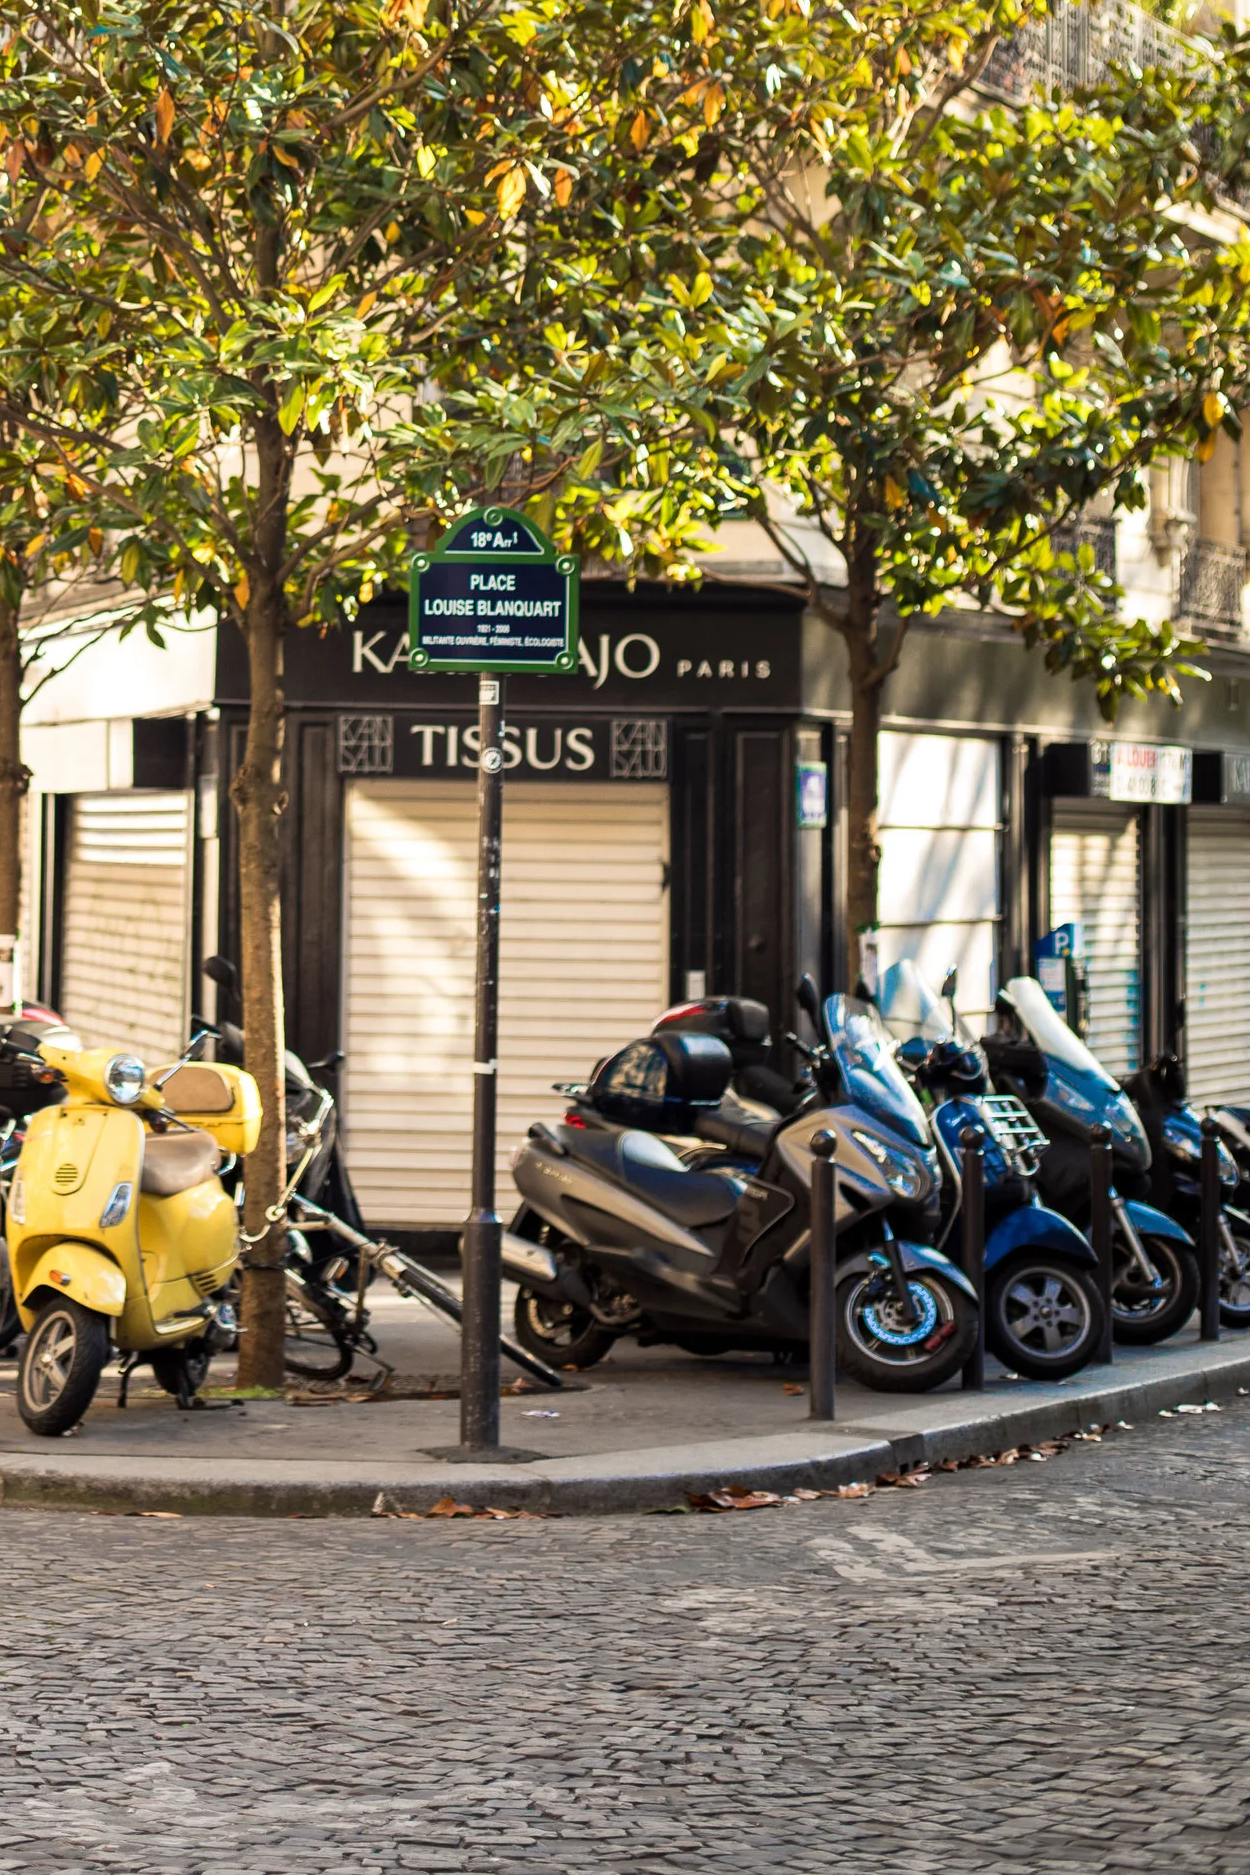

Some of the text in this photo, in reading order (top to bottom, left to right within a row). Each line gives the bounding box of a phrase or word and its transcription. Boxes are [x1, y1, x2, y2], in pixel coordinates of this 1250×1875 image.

[470, 574, 516, 591] PLACE
[424, 599, 562, 617] LOUISE BLANQUART
[676, 659, 771, 679] PARIS
[410, 725, 595, 771] TISSUS
[1054, 931, 1070, 955] P
